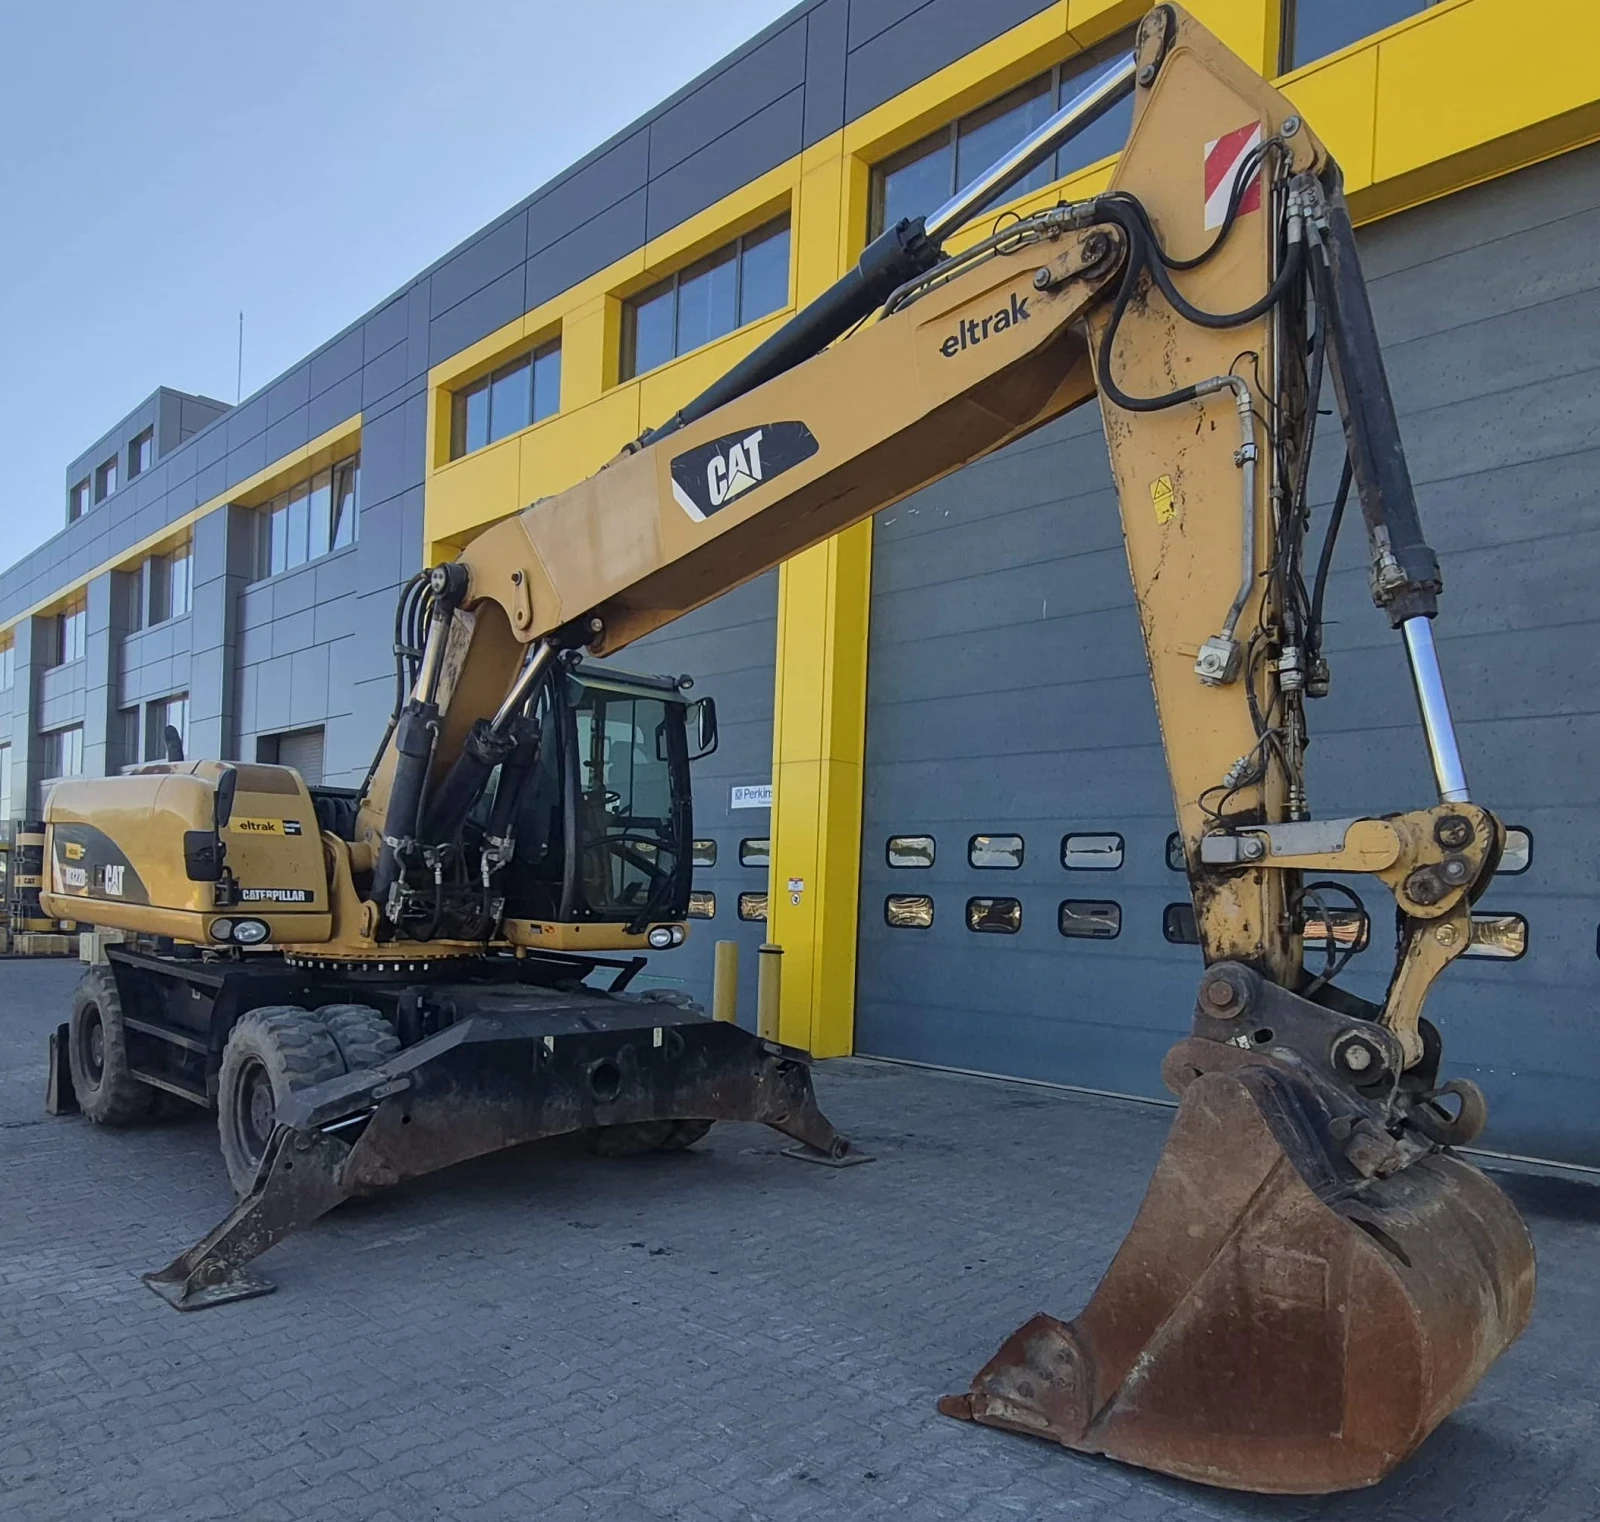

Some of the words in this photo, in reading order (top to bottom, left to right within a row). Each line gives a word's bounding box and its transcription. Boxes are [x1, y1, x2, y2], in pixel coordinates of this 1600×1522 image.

[939, 292, 1031, 357] eltrak
[707, 429, 763, 506] CAT
[239, 820, 276, 832] eltrak
[105, 864, 125, 896] CAT
[242, 889, 306, 902] CATERPILLAR
